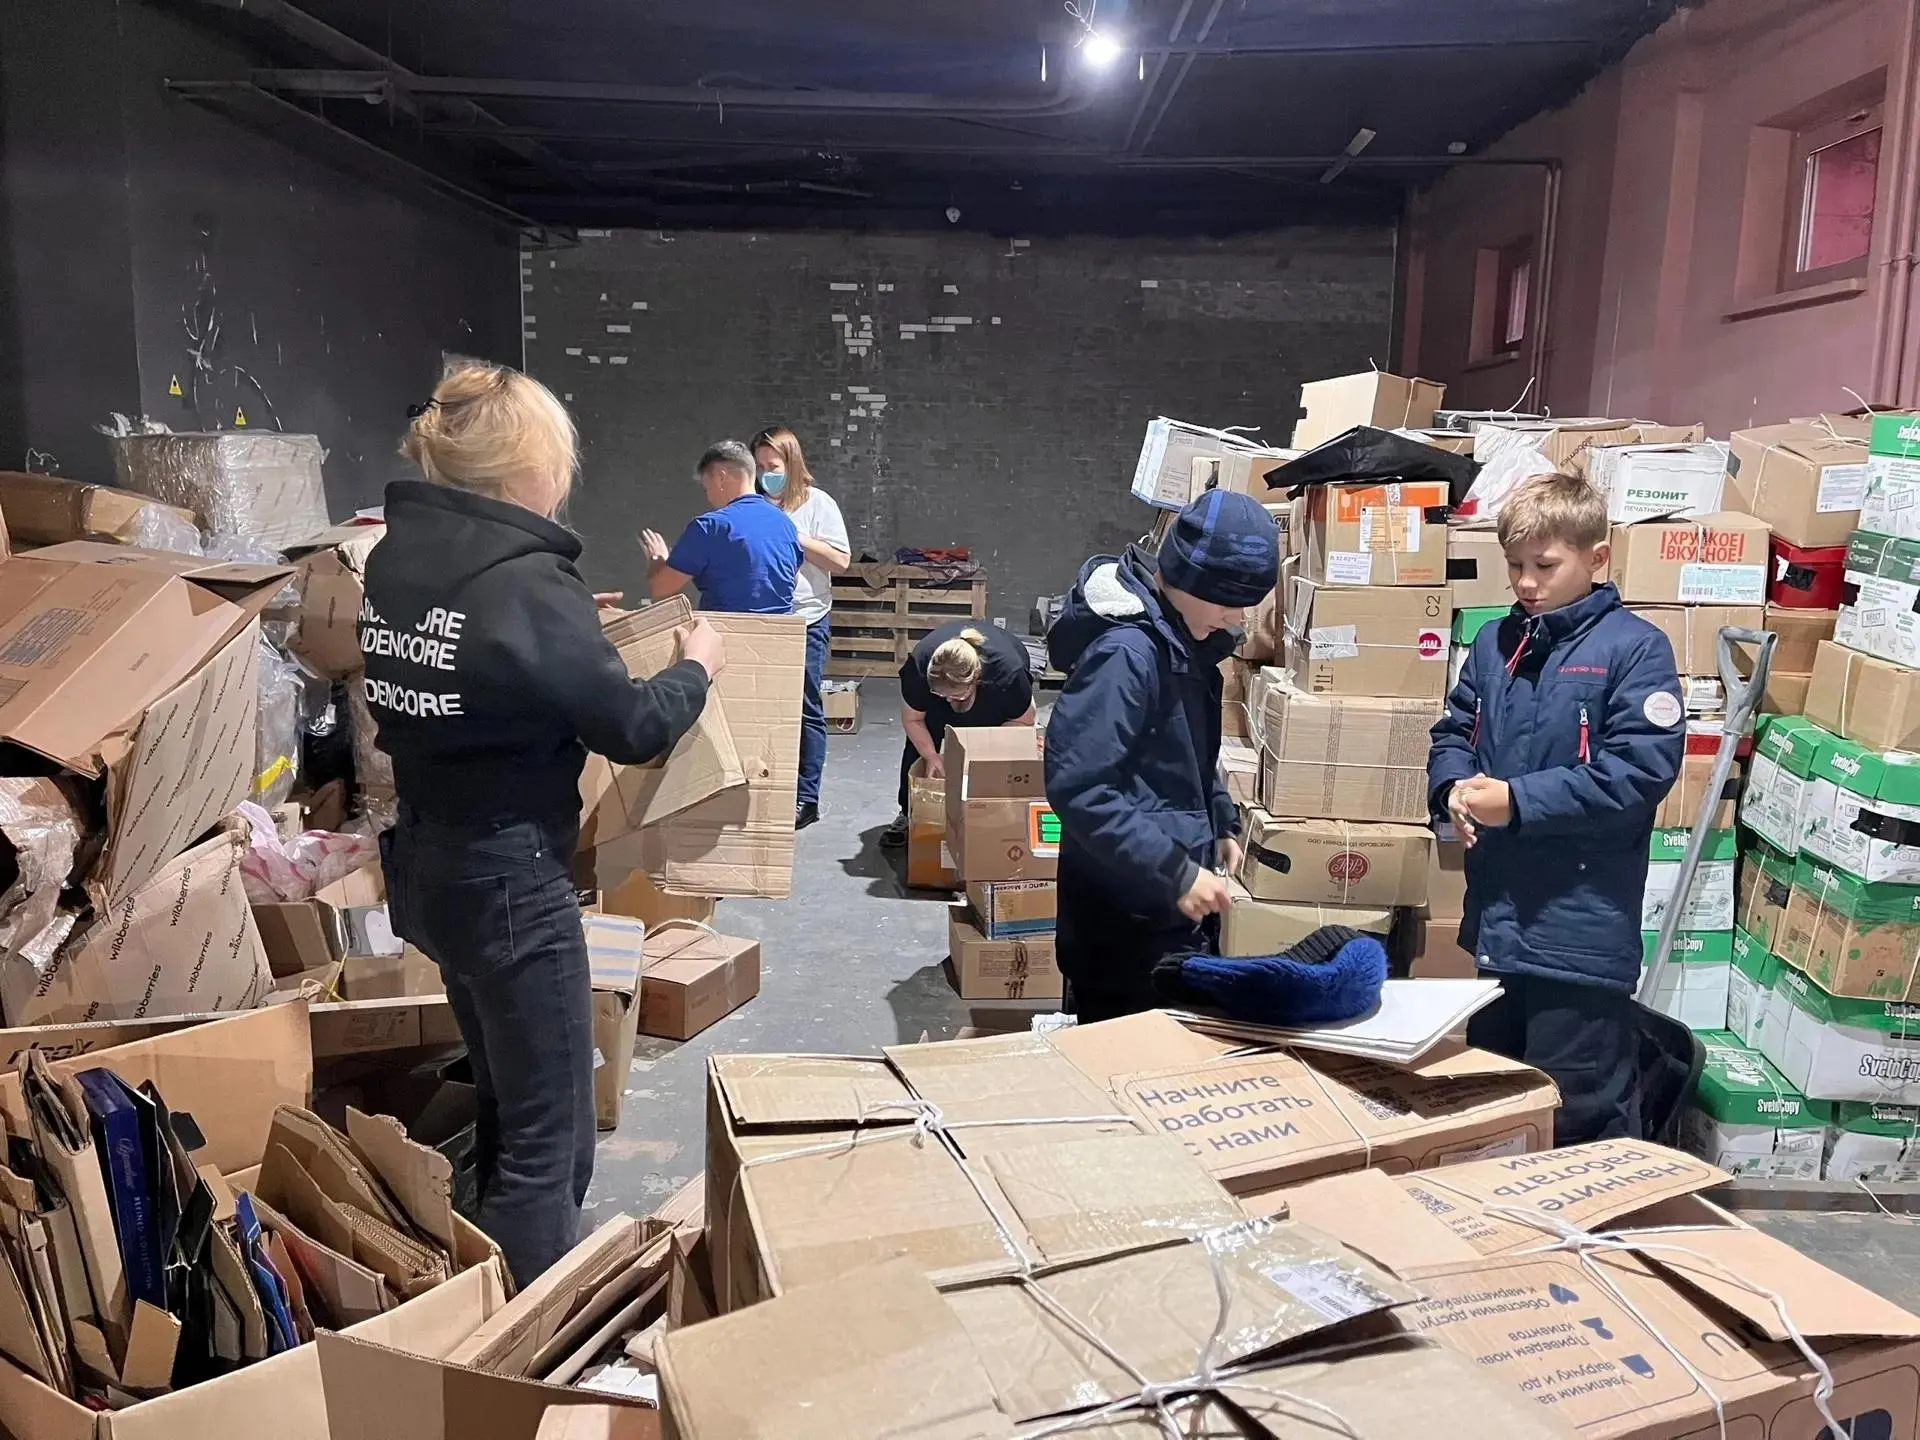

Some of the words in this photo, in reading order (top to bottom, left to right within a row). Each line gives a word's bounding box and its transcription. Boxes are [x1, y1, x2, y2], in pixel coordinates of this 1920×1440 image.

[1627, 488, 1689, 501] РЕЗОНИТ
[1666, 546, 1737, 562] ВКУНОЕ
[1425, 595, 1440, 617] C2
[361, 627, 457, 671] DENCORE
[364, 678, 465, 717] DENCORE
[170, 867, 192, 927] wildberries
[110, 896, 136, 961] wildberries
[1673, 936, 1704, 951] etoCopy
[187, 930, 213, 993] wildberries
[1859, 1053, 1920, 1083] SvetoCop
[1137, 1075, 1281, 1107] Начните
[1158, 1096, 1314, 1136] работать
[1757, 1098, 1800, 1116] SvetoCopy
[1208, 1121, 1300, 1151] нами
[1493, 1150, 1650, 1196] работать
[1500, 1148, 1588, 1171] нами
[1537, 1162, 1696, 1211] Начните
[1472, 1298, 1550, 1319] Обеспечим
[1508, 1322, 1576, 1341] клиентов
[1516, 1335, 1590, 1358] Приведем
[1556, 1361, 1616, 1381] выручку
[1558, 1374, 1632, 1398] Увеличим
